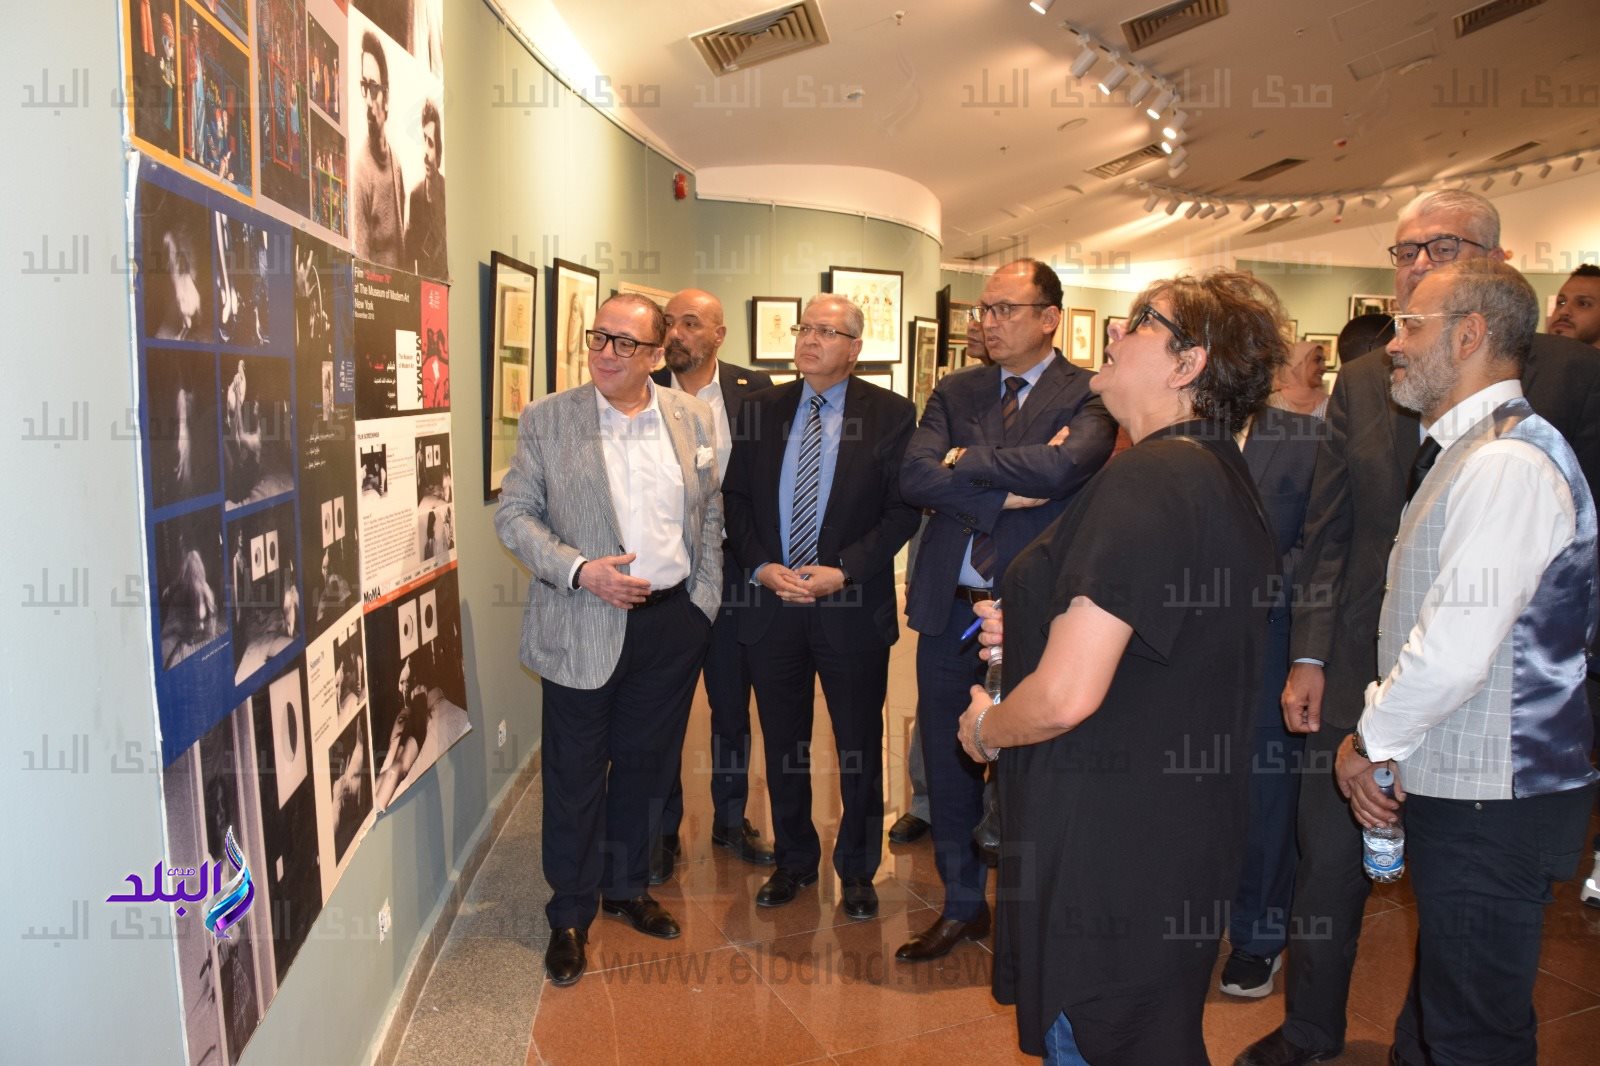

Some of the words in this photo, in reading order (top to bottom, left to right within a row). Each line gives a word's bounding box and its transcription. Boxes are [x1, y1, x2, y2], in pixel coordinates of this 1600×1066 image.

[354, 267, 364, 278] Film
[359, 283, 368, 295] The
[368, 285, 385, 298] Museum
[390, 290, 404, 302] Modern
[354, 298, 364, 309] New
[365, 299, 374, 311] York
[363, 586, 382, 605] MoMA
